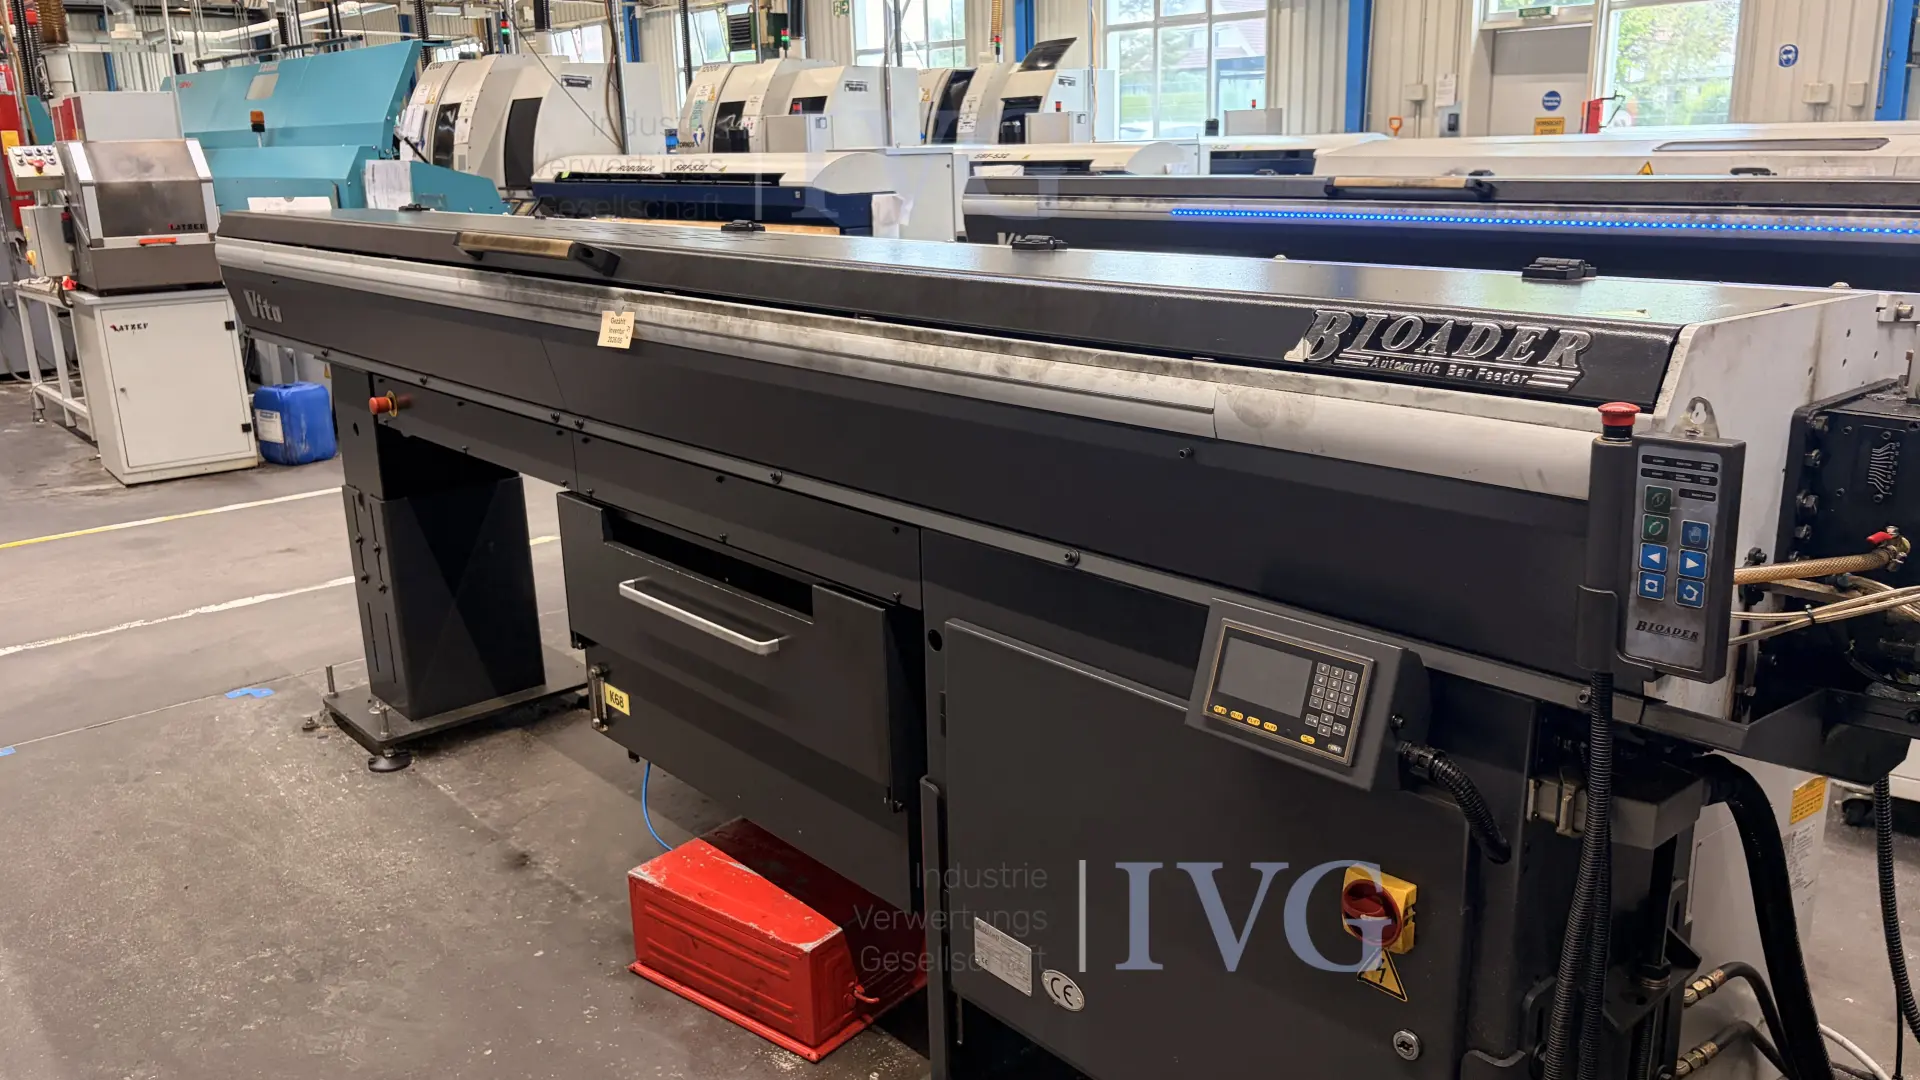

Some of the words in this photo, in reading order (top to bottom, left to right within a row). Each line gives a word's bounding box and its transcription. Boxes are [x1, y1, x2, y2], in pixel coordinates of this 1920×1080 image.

[1370, 356, 1440, 375] Automatic
[1446, 364, 1473, 379] Bar
[1475, 367, 1529, 384] Feeder
[609, 690, 624, 708] K68
